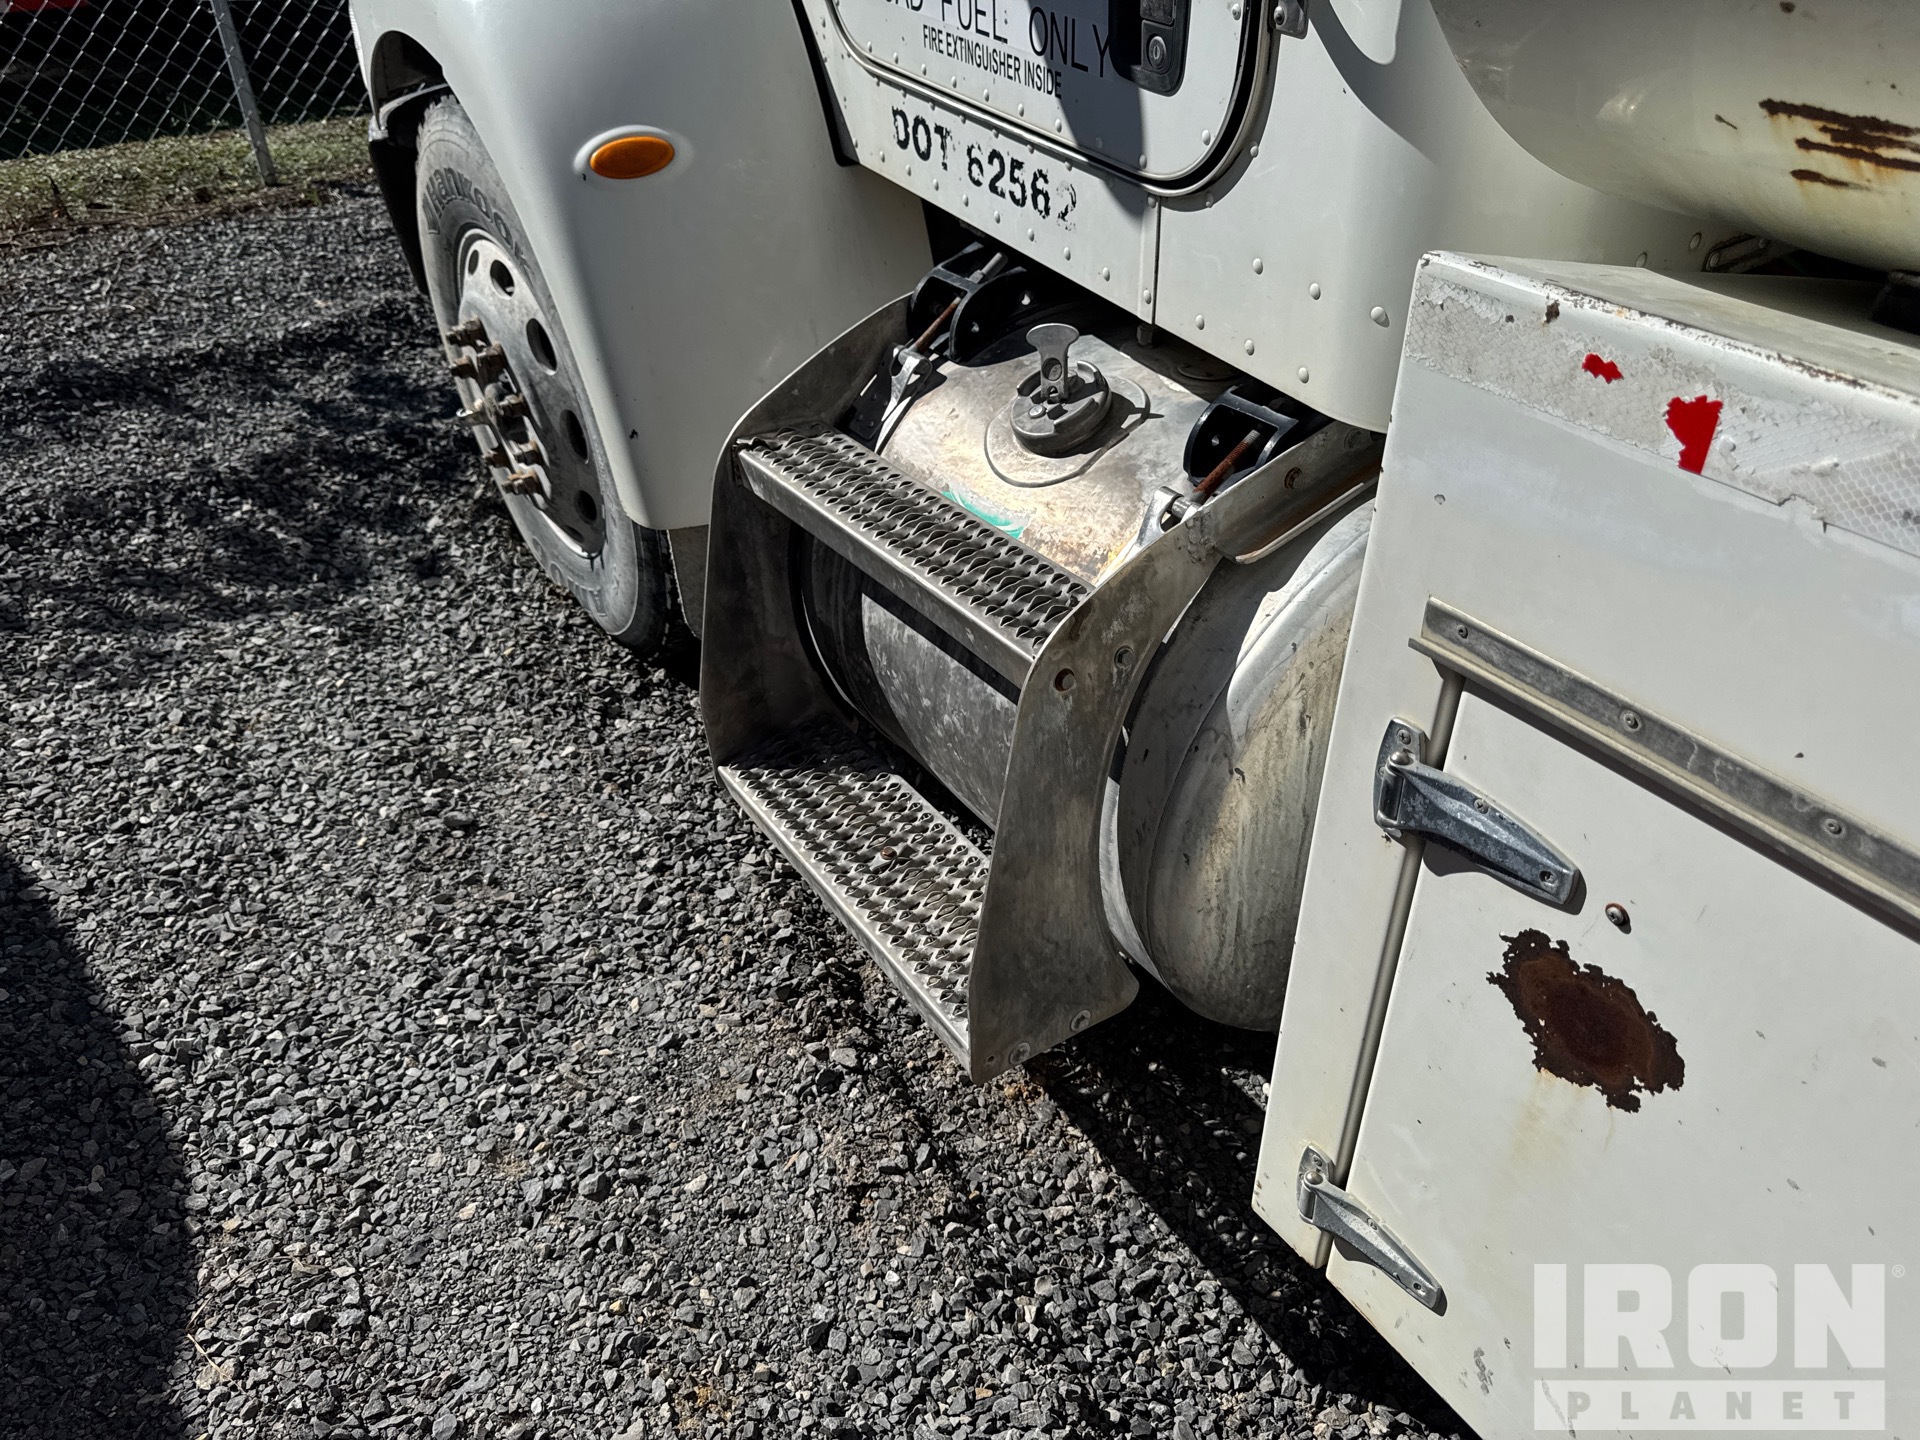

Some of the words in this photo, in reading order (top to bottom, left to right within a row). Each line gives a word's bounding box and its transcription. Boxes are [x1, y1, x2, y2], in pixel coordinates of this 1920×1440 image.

[922, 24, 944, 54] FIRE
[946, 31, 1022, 86] EXTINGUISHER
[1024, 59, 1062, 99] INSIDE
[1029, 6, 1109, 78] ONLY
[892, 105, 953, 171] DOT
[966, 142, 1077, 231] 62562
